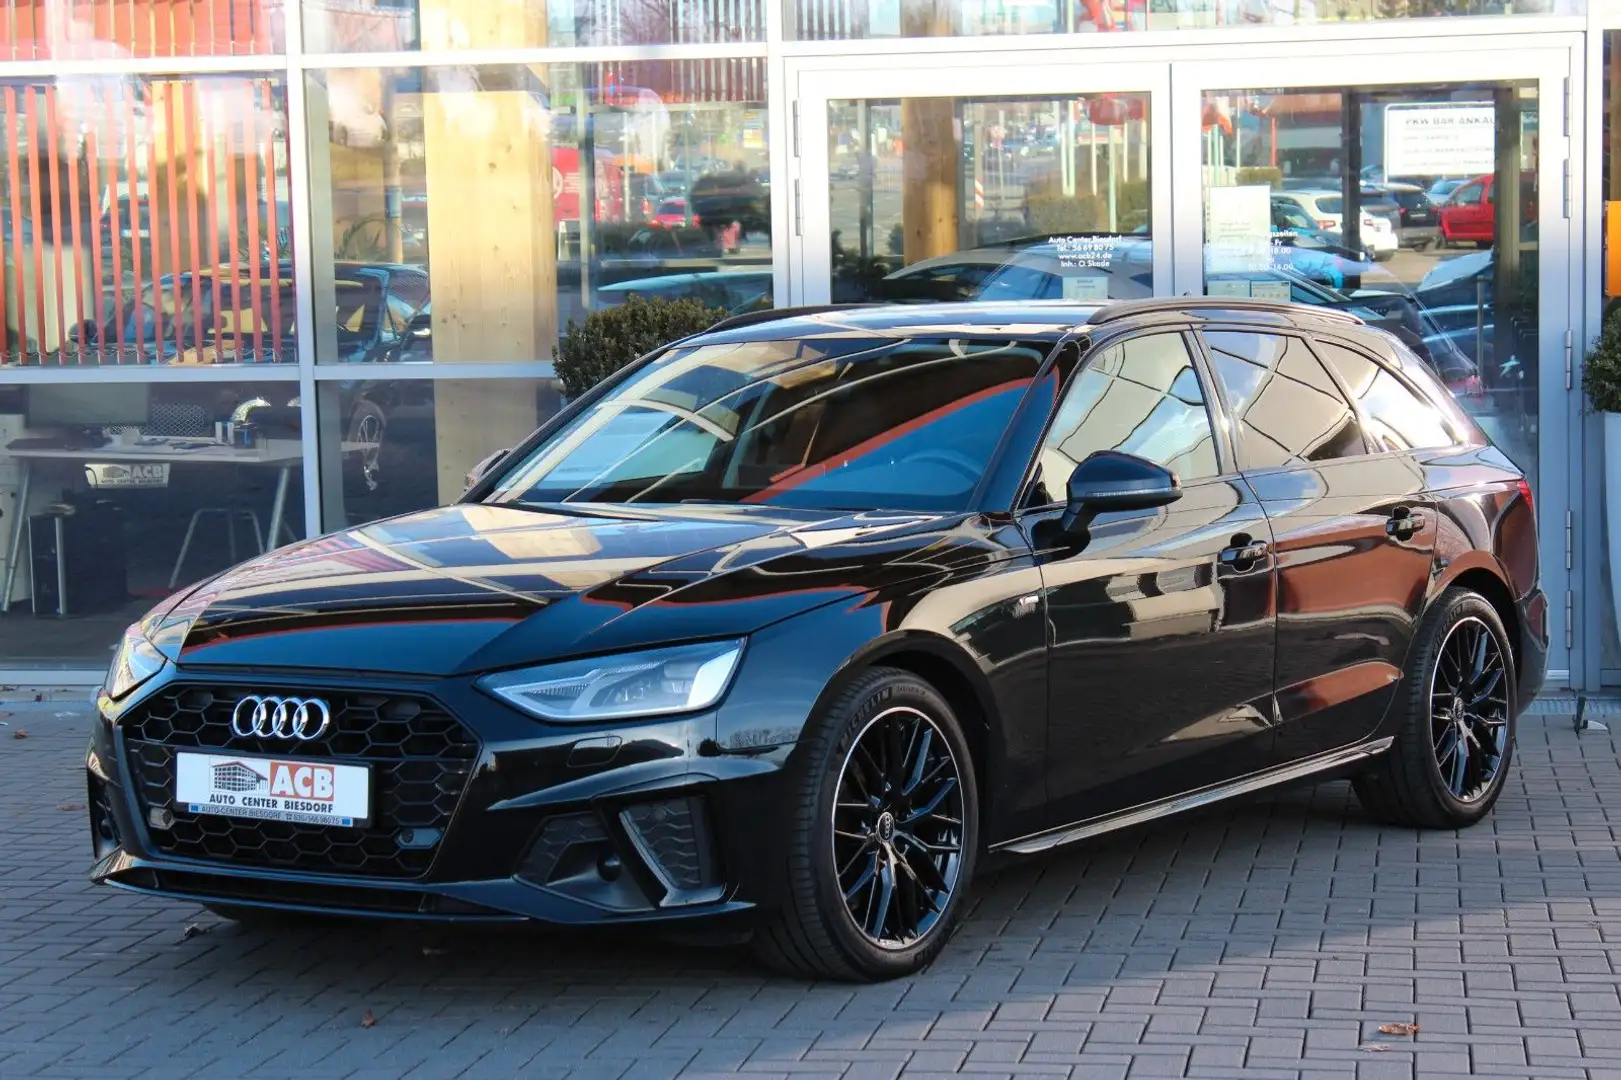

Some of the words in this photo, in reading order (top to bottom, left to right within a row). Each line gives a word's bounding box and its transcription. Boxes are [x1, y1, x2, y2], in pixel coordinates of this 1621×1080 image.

[1048, 236, 1066, 244] Auto
[131, 466, 162, 478] ACB
[271, 764, 334, 799] ACB
[209, 793, 236, 806] AUTO
[242, 796, 278, 809] CENTER
[284, 799, 334, 814] BIESDORF
